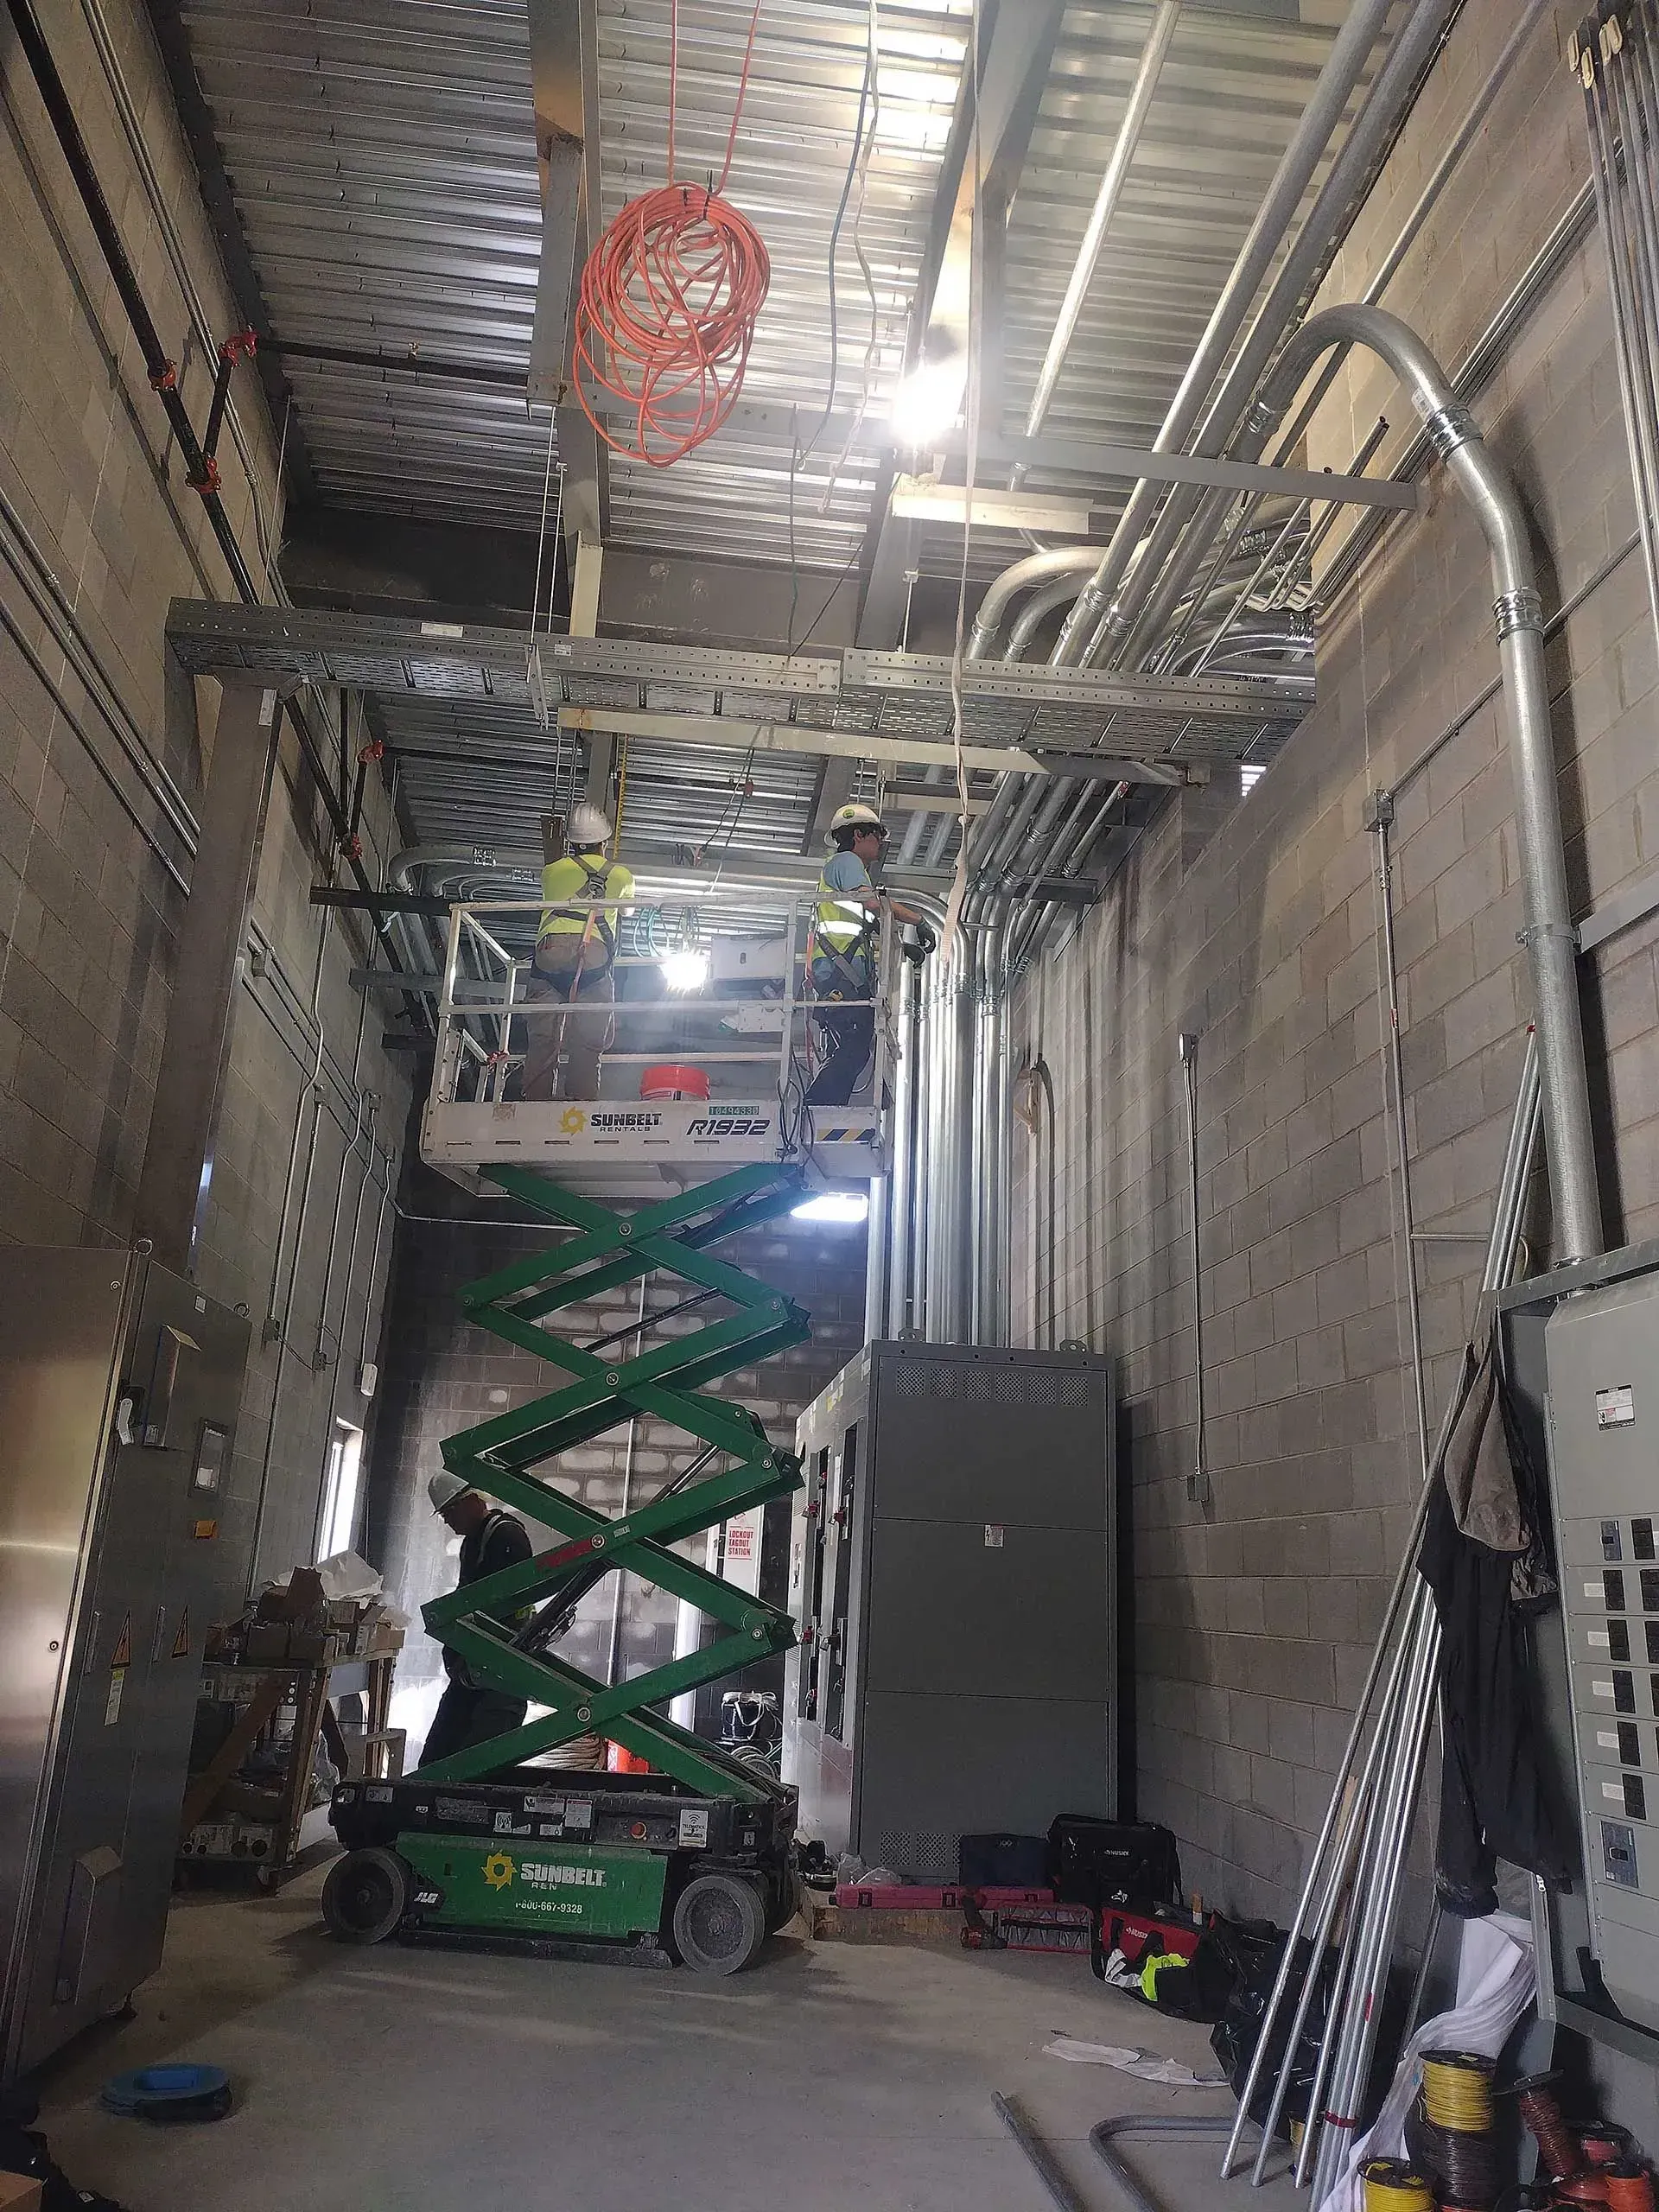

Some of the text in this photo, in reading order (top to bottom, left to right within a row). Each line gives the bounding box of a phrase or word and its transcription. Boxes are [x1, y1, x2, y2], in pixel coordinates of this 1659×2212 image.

[591, 1113, 662, 1127] SUNBELT
[687, 1120, 770, 1135] R1932
[521, 1863, 605, 1886] SUNBELT
[414, 1892, 439, 1904] JLG
